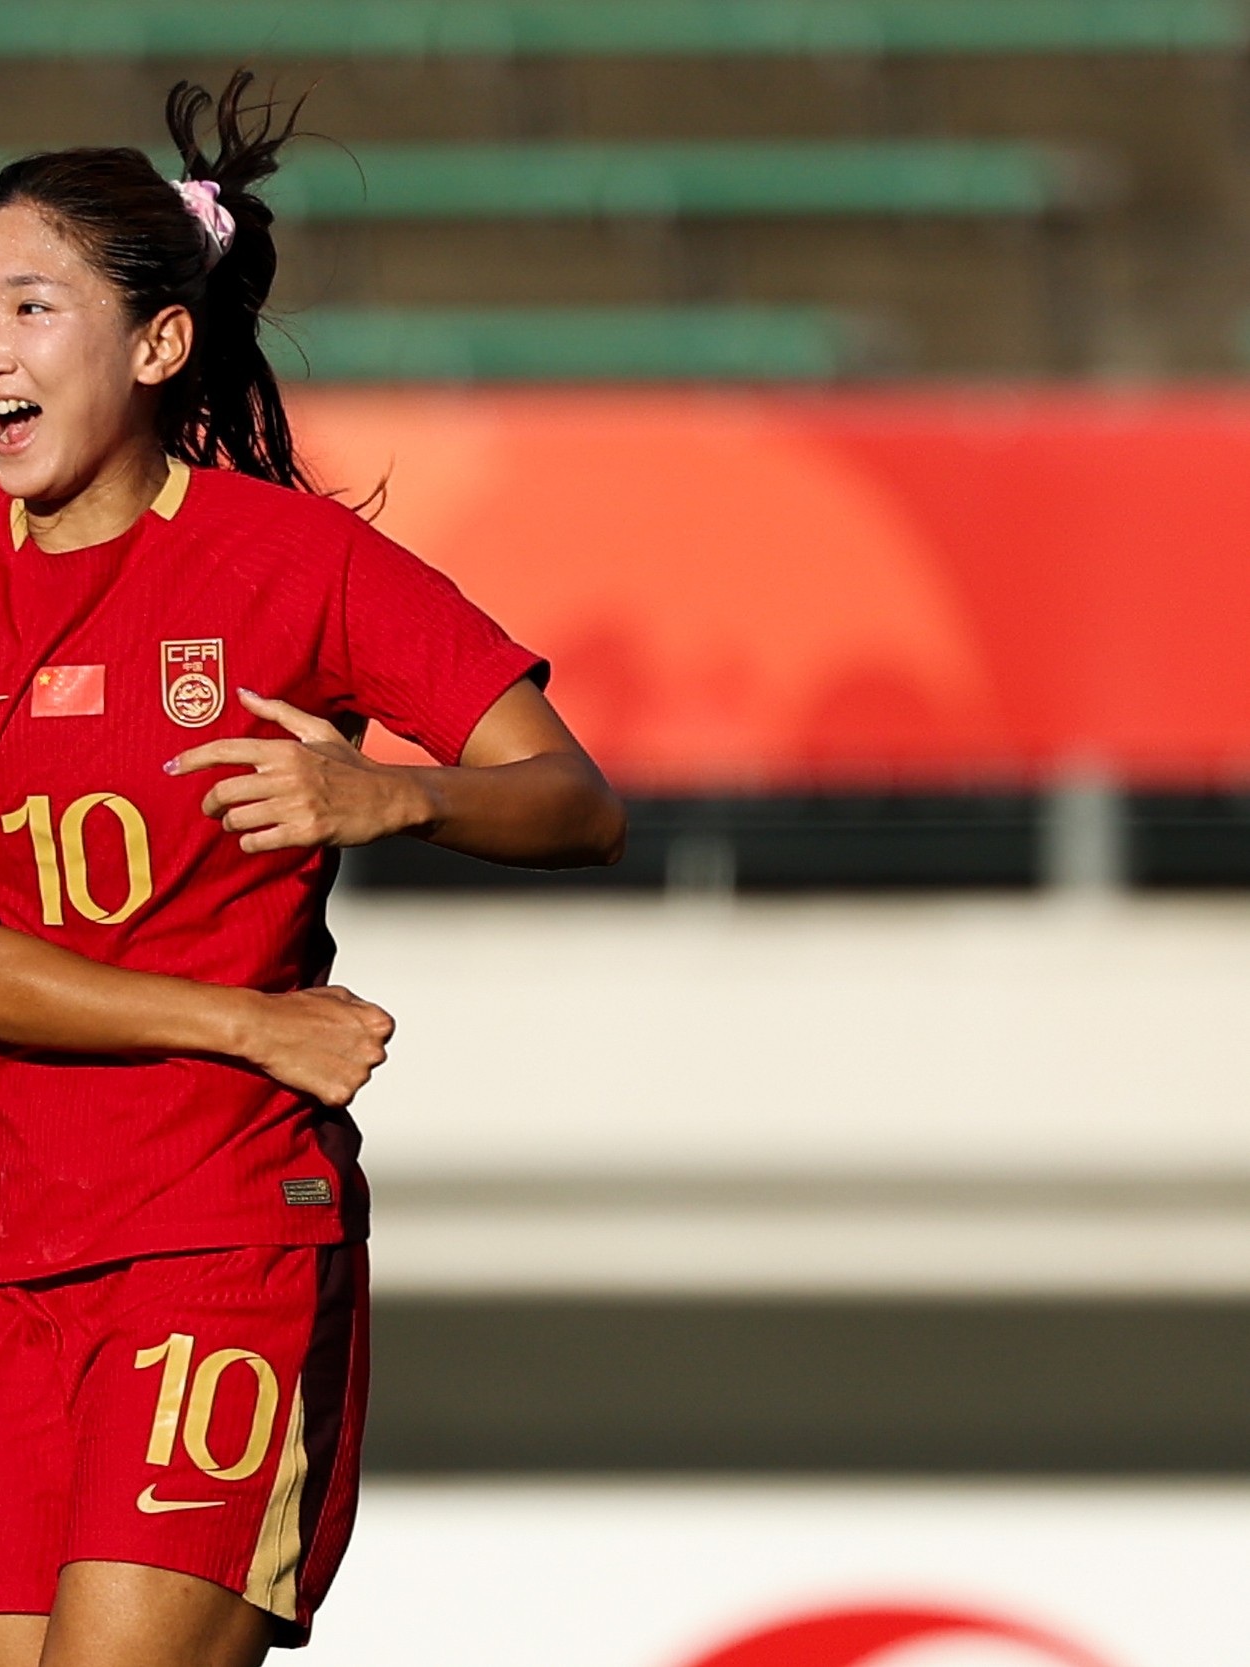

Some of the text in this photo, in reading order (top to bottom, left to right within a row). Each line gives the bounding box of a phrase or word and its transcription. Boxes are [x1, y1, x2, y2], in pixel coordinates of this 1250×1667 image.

[167, 645, 217, 662] CFA
[1, 792, 153, 926] 10
[134, 1333, 279, 1481] 10
